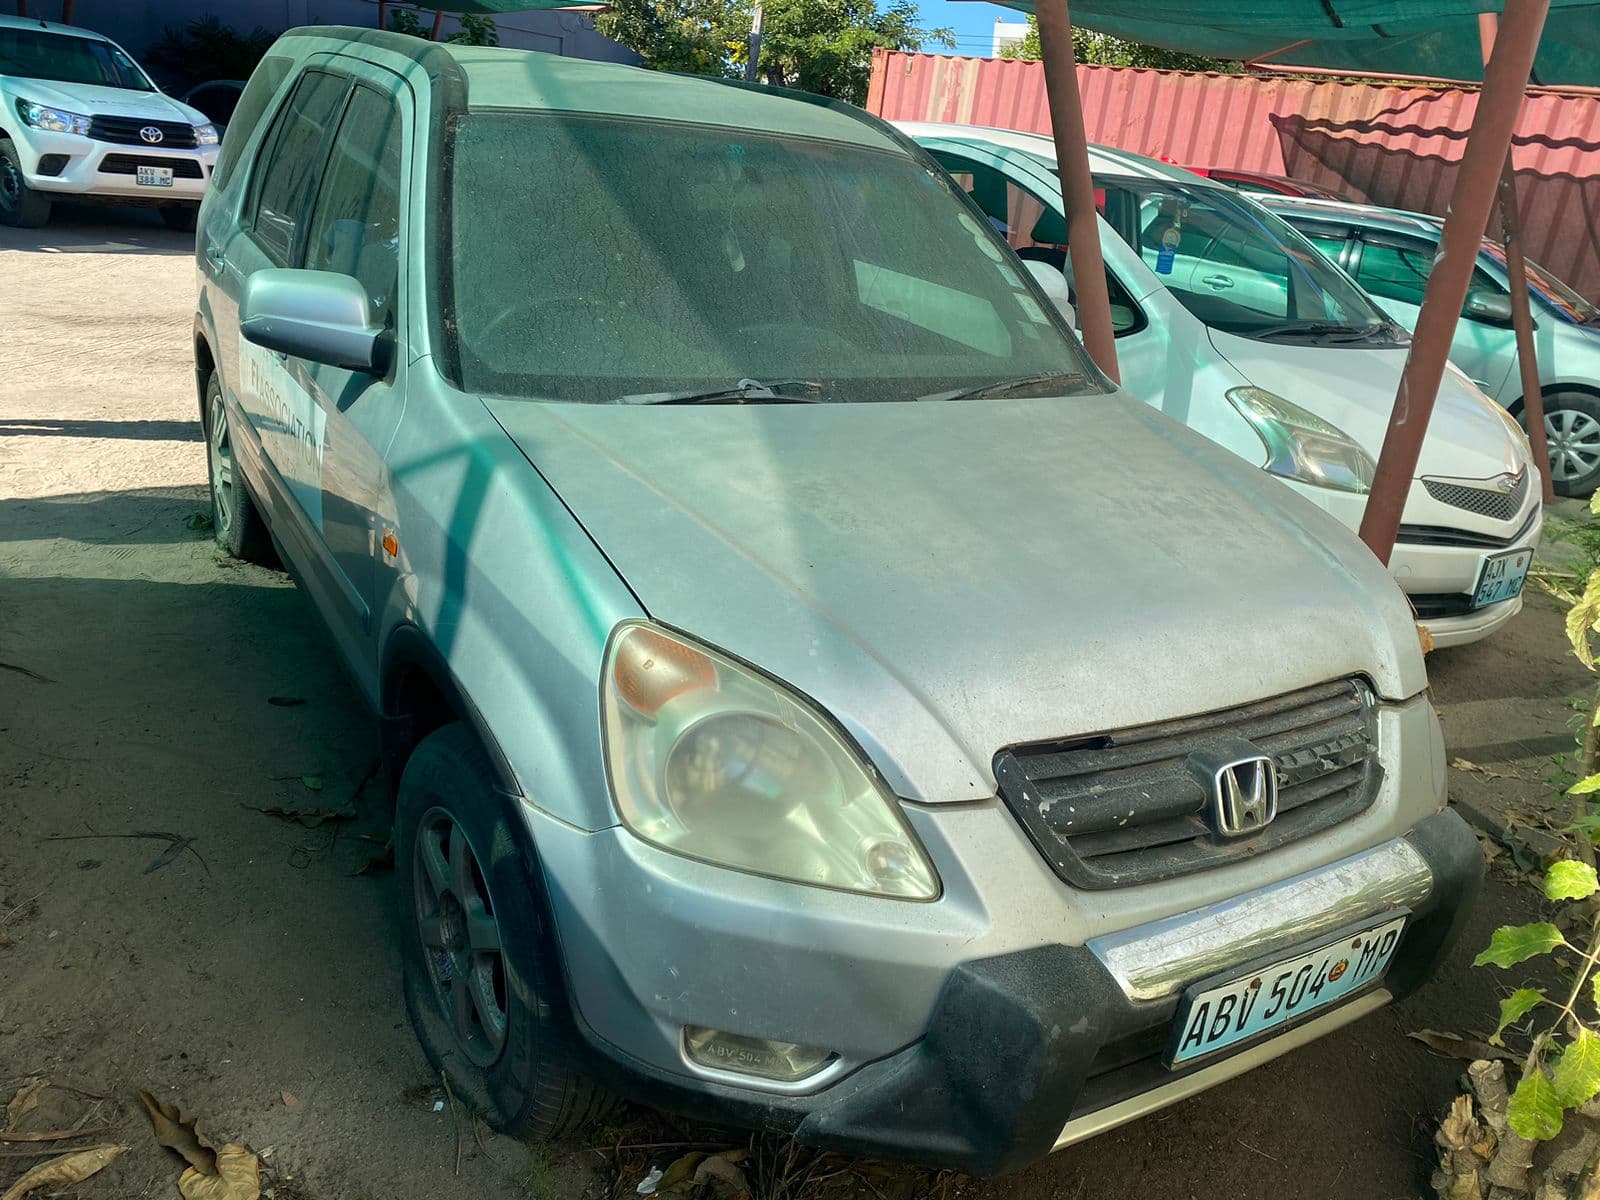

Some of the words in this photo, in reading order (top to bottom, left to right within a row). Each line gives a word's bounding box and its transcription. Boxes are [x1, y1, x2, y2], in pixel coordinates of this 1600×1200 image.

[139, 167, 155, 176] AKV
[1486, 558, 1509, 580] AJX
[1477, 580, 1503, 603] 547
[1181, 979, 1262, 1052] ABV
[1263, 959, 1330, 1020] 504
[1352, 929, 1398, 983] MP
[707, 1044, 735, 1058] ABV
